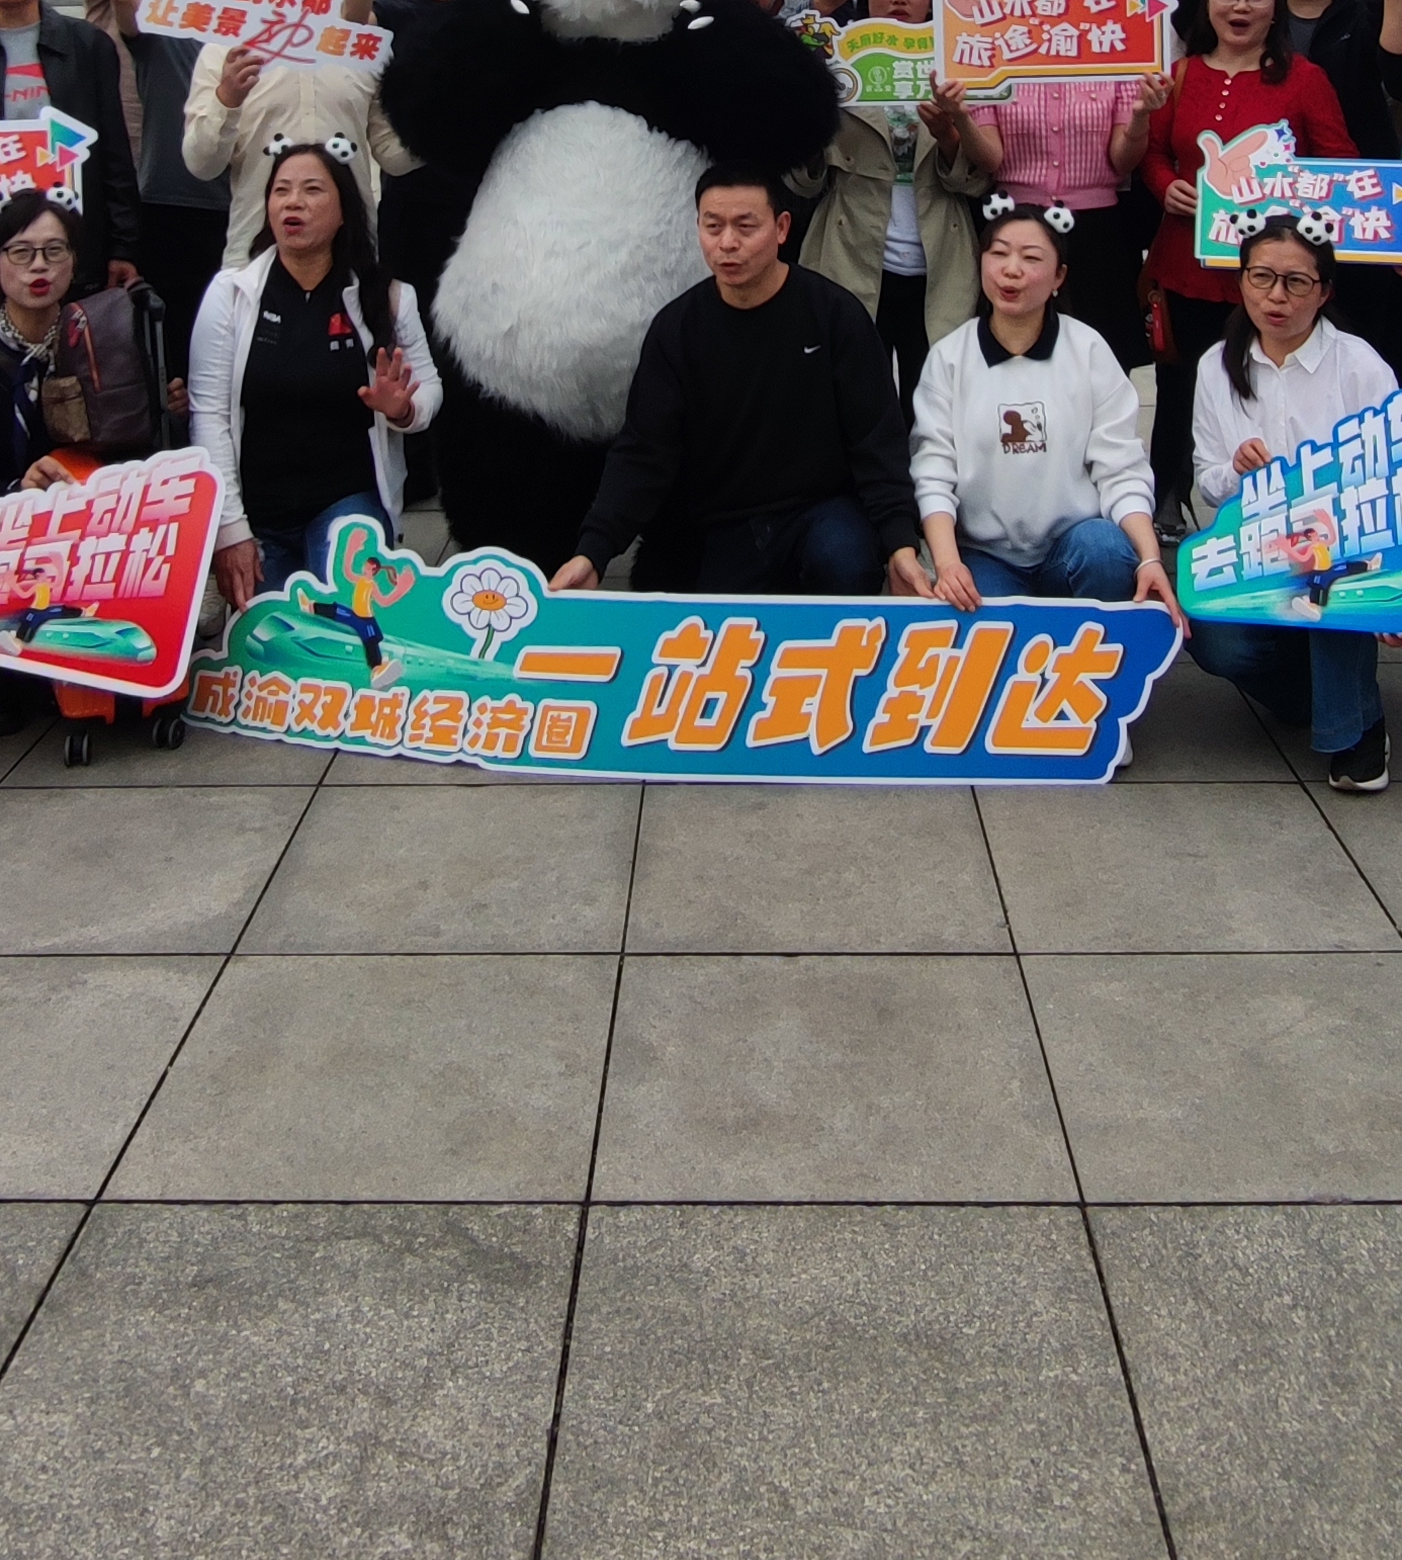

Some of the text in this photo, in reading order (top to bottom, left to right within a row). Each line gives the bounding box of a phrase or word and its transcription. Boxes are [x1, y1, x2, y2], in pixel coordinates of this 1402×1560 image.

[1002, 442, 1047, 455] DREAM
[192, 666, 596, 761] 成渝双城经济圈
[514, 616, 1126, 754] 一站式到达
